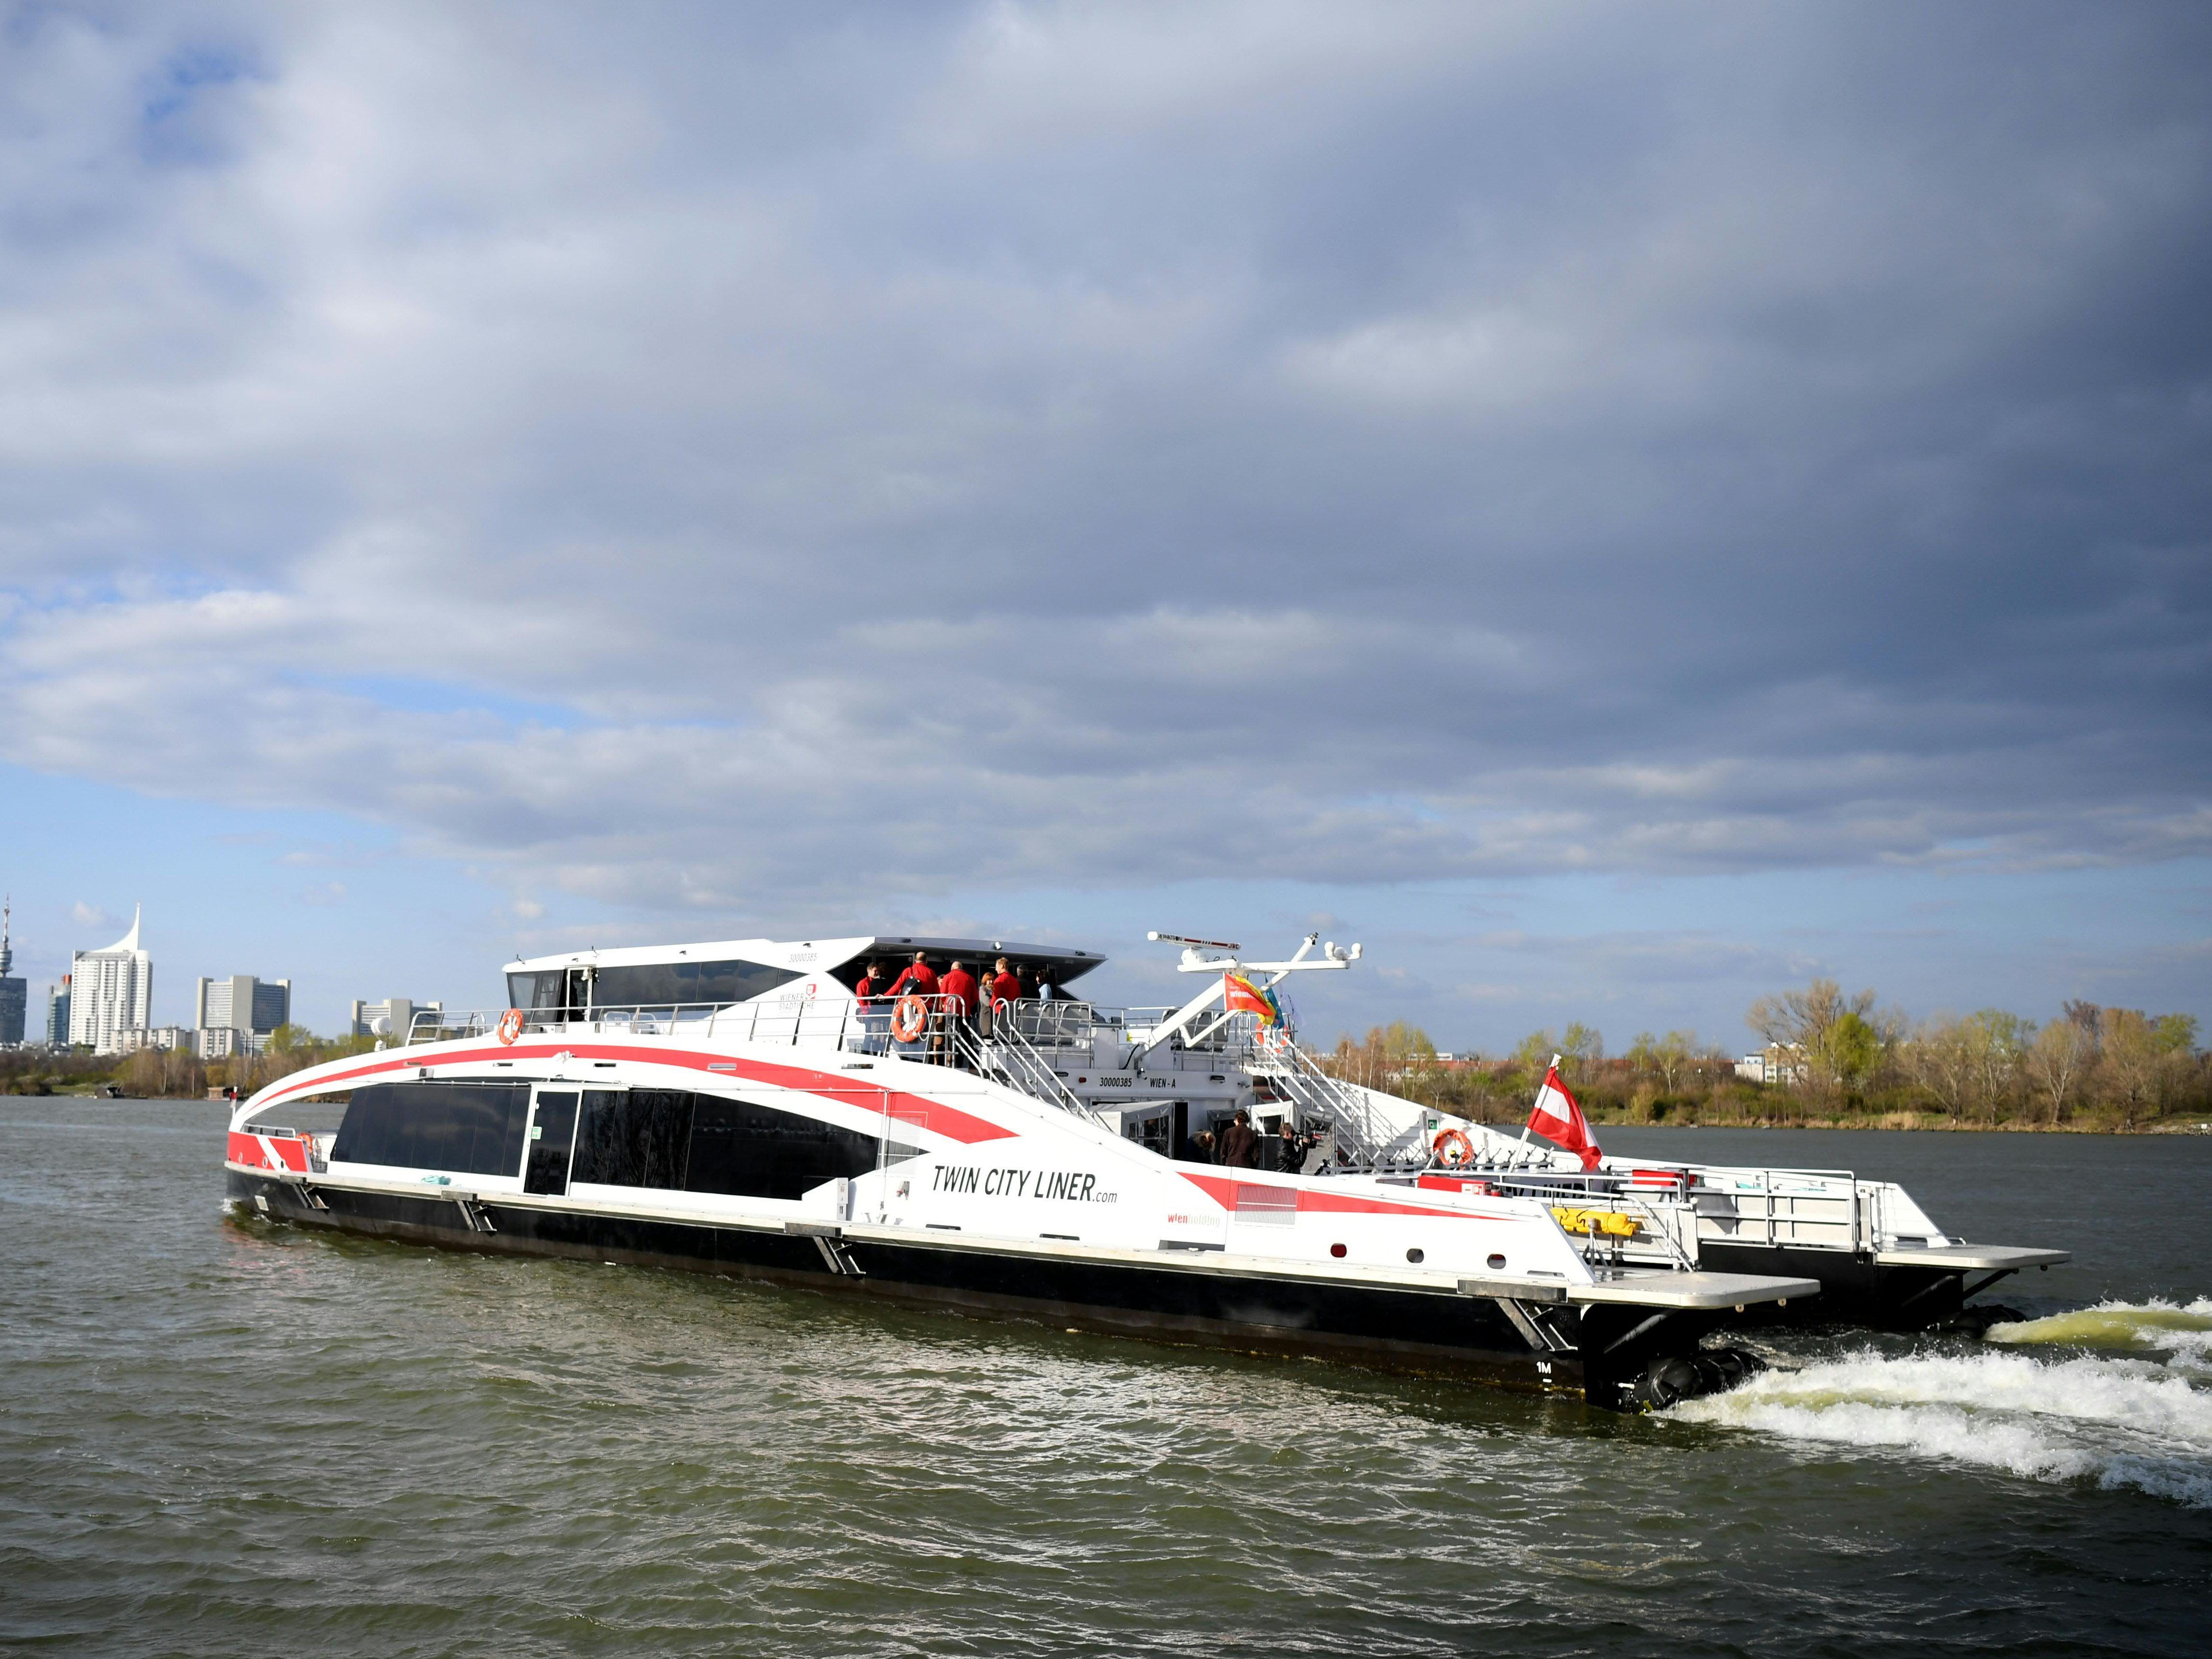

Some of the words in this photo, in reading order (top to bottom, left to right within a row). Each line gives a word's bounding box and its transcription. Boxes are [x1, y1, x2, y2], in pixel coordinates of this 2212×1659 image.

[789, 953, 817, 962] 30000385
[780, 993, 804, 1001] WIENER
[1099, 1077, 1132, 1087] 30000385
[933, 1165, 981, 1194] TWIN
[985, 1168, 1031, 1197] CITY
[1536, 1361, 1551, 1374] 1M
